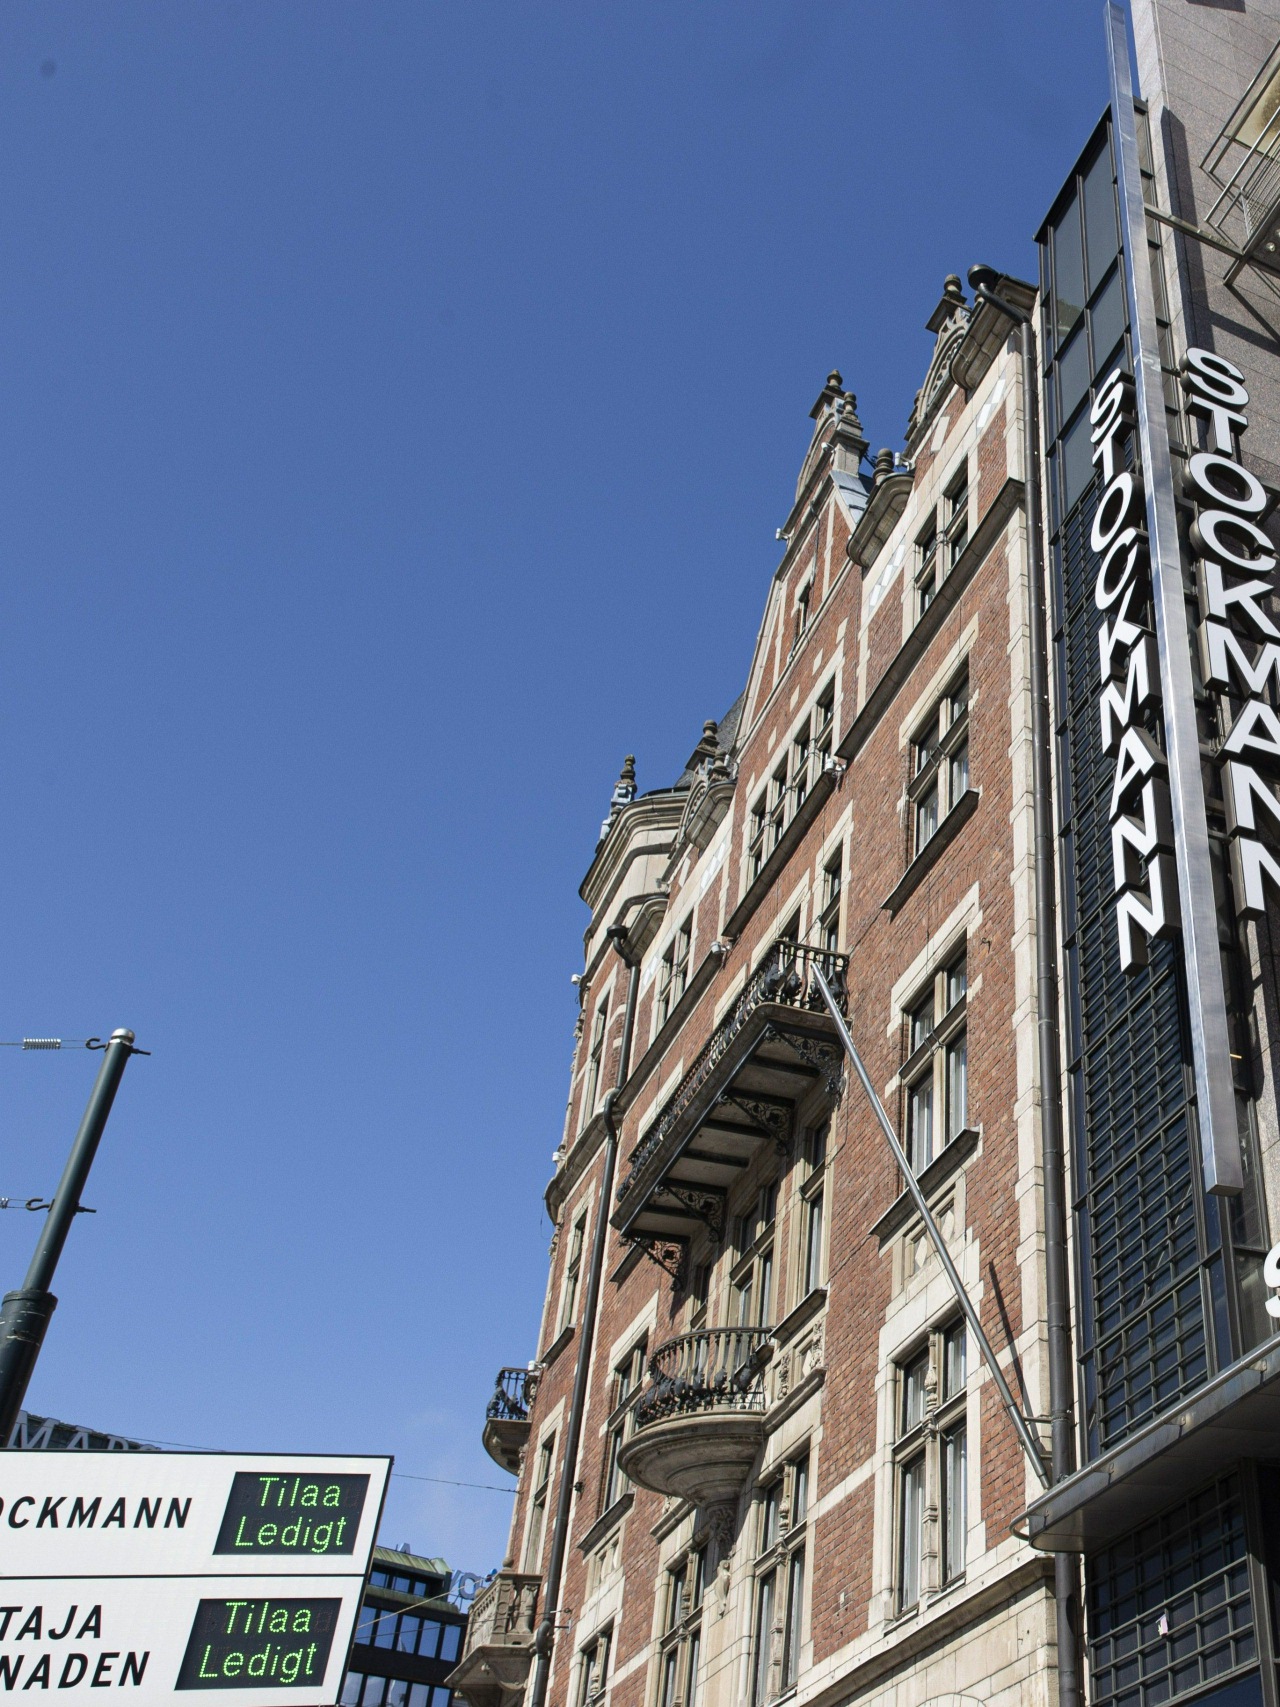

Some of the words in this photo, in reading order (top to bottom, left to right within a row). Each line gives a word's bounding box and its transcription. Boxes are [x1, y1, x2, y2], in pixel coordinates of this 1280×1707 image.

[1090, 368, 1168, 974] STOCKMANN
[259, 1477, 340, 1507] Tilaa
[0, 1496, 192, 1529] CKMANN
[235, 1516, 347, 1553] Ledigt
[225, 1602, 311, 1634] Tilaa
[199, 1643, 316, 1683] Ledigt
